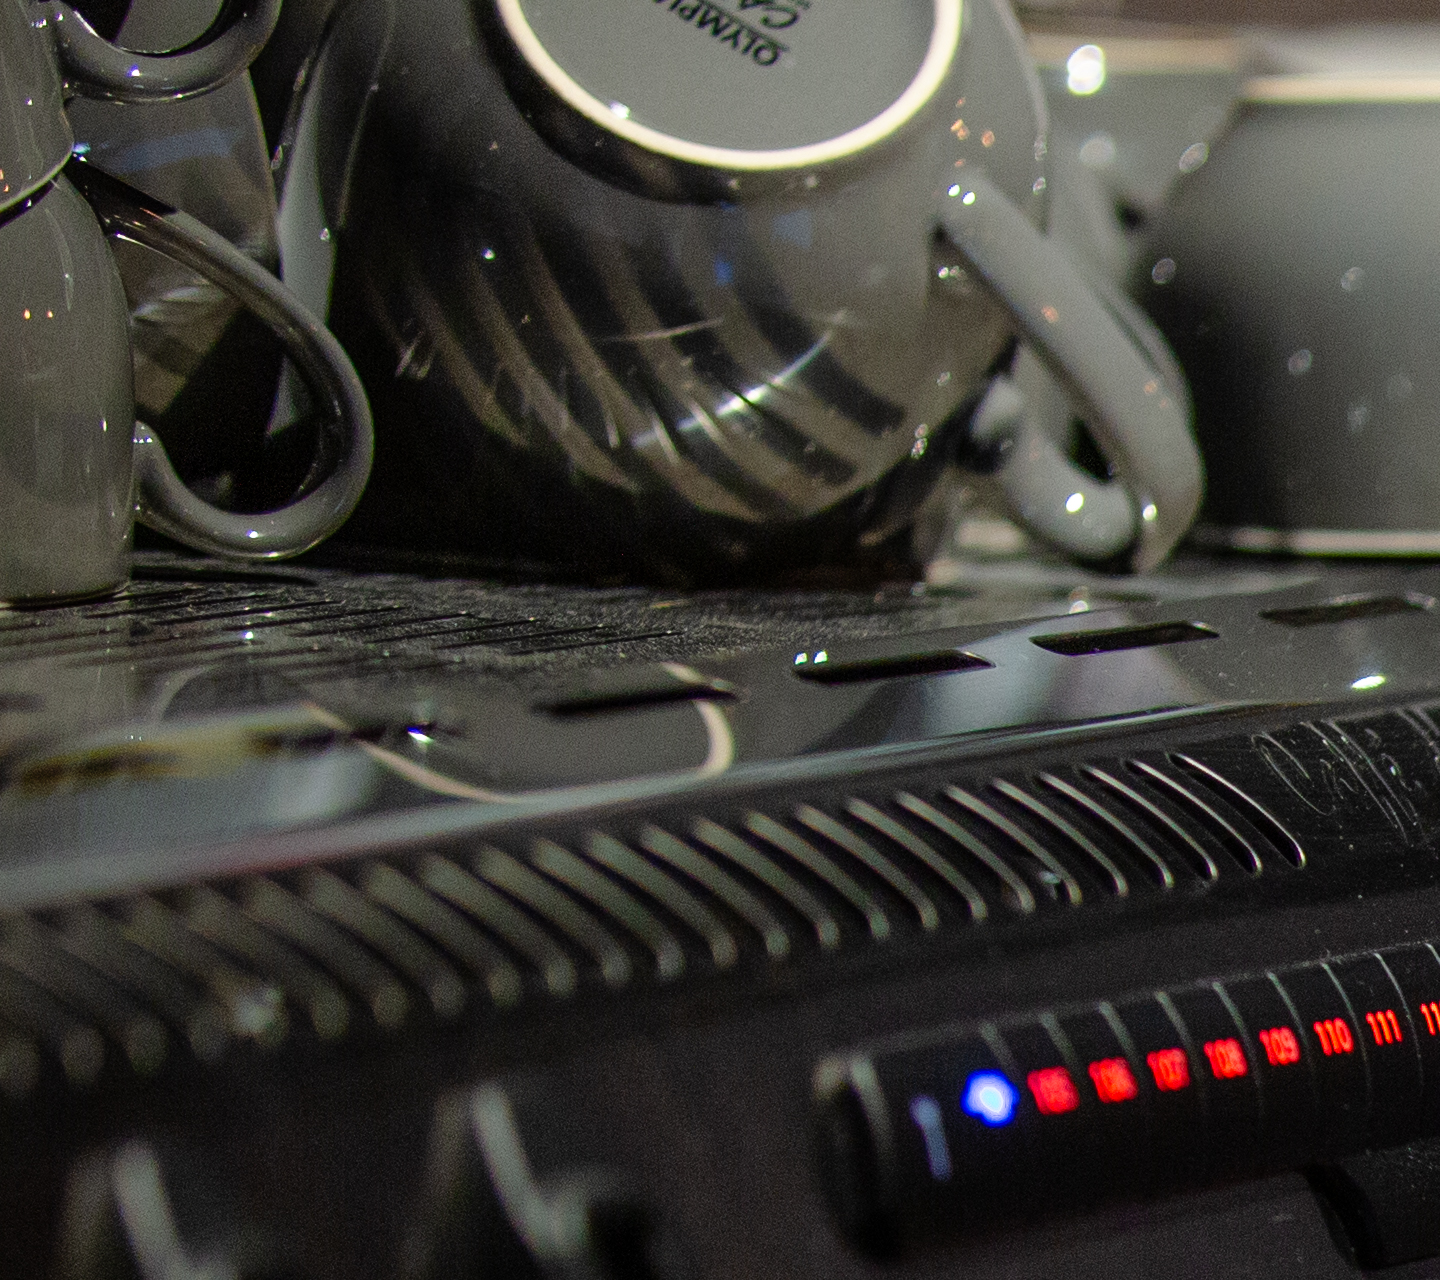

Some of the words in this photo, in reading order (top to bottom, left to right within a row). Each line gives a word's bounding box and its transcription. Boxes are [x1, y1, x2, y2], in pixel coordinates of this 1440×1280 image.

[1204, 1039, 1247, 1078] 108
[1260, 1027, 1299, 1065] 109
[1314, 1018, 1353, 1055] 110
[1366, 1010, 1402, 1045] 111
